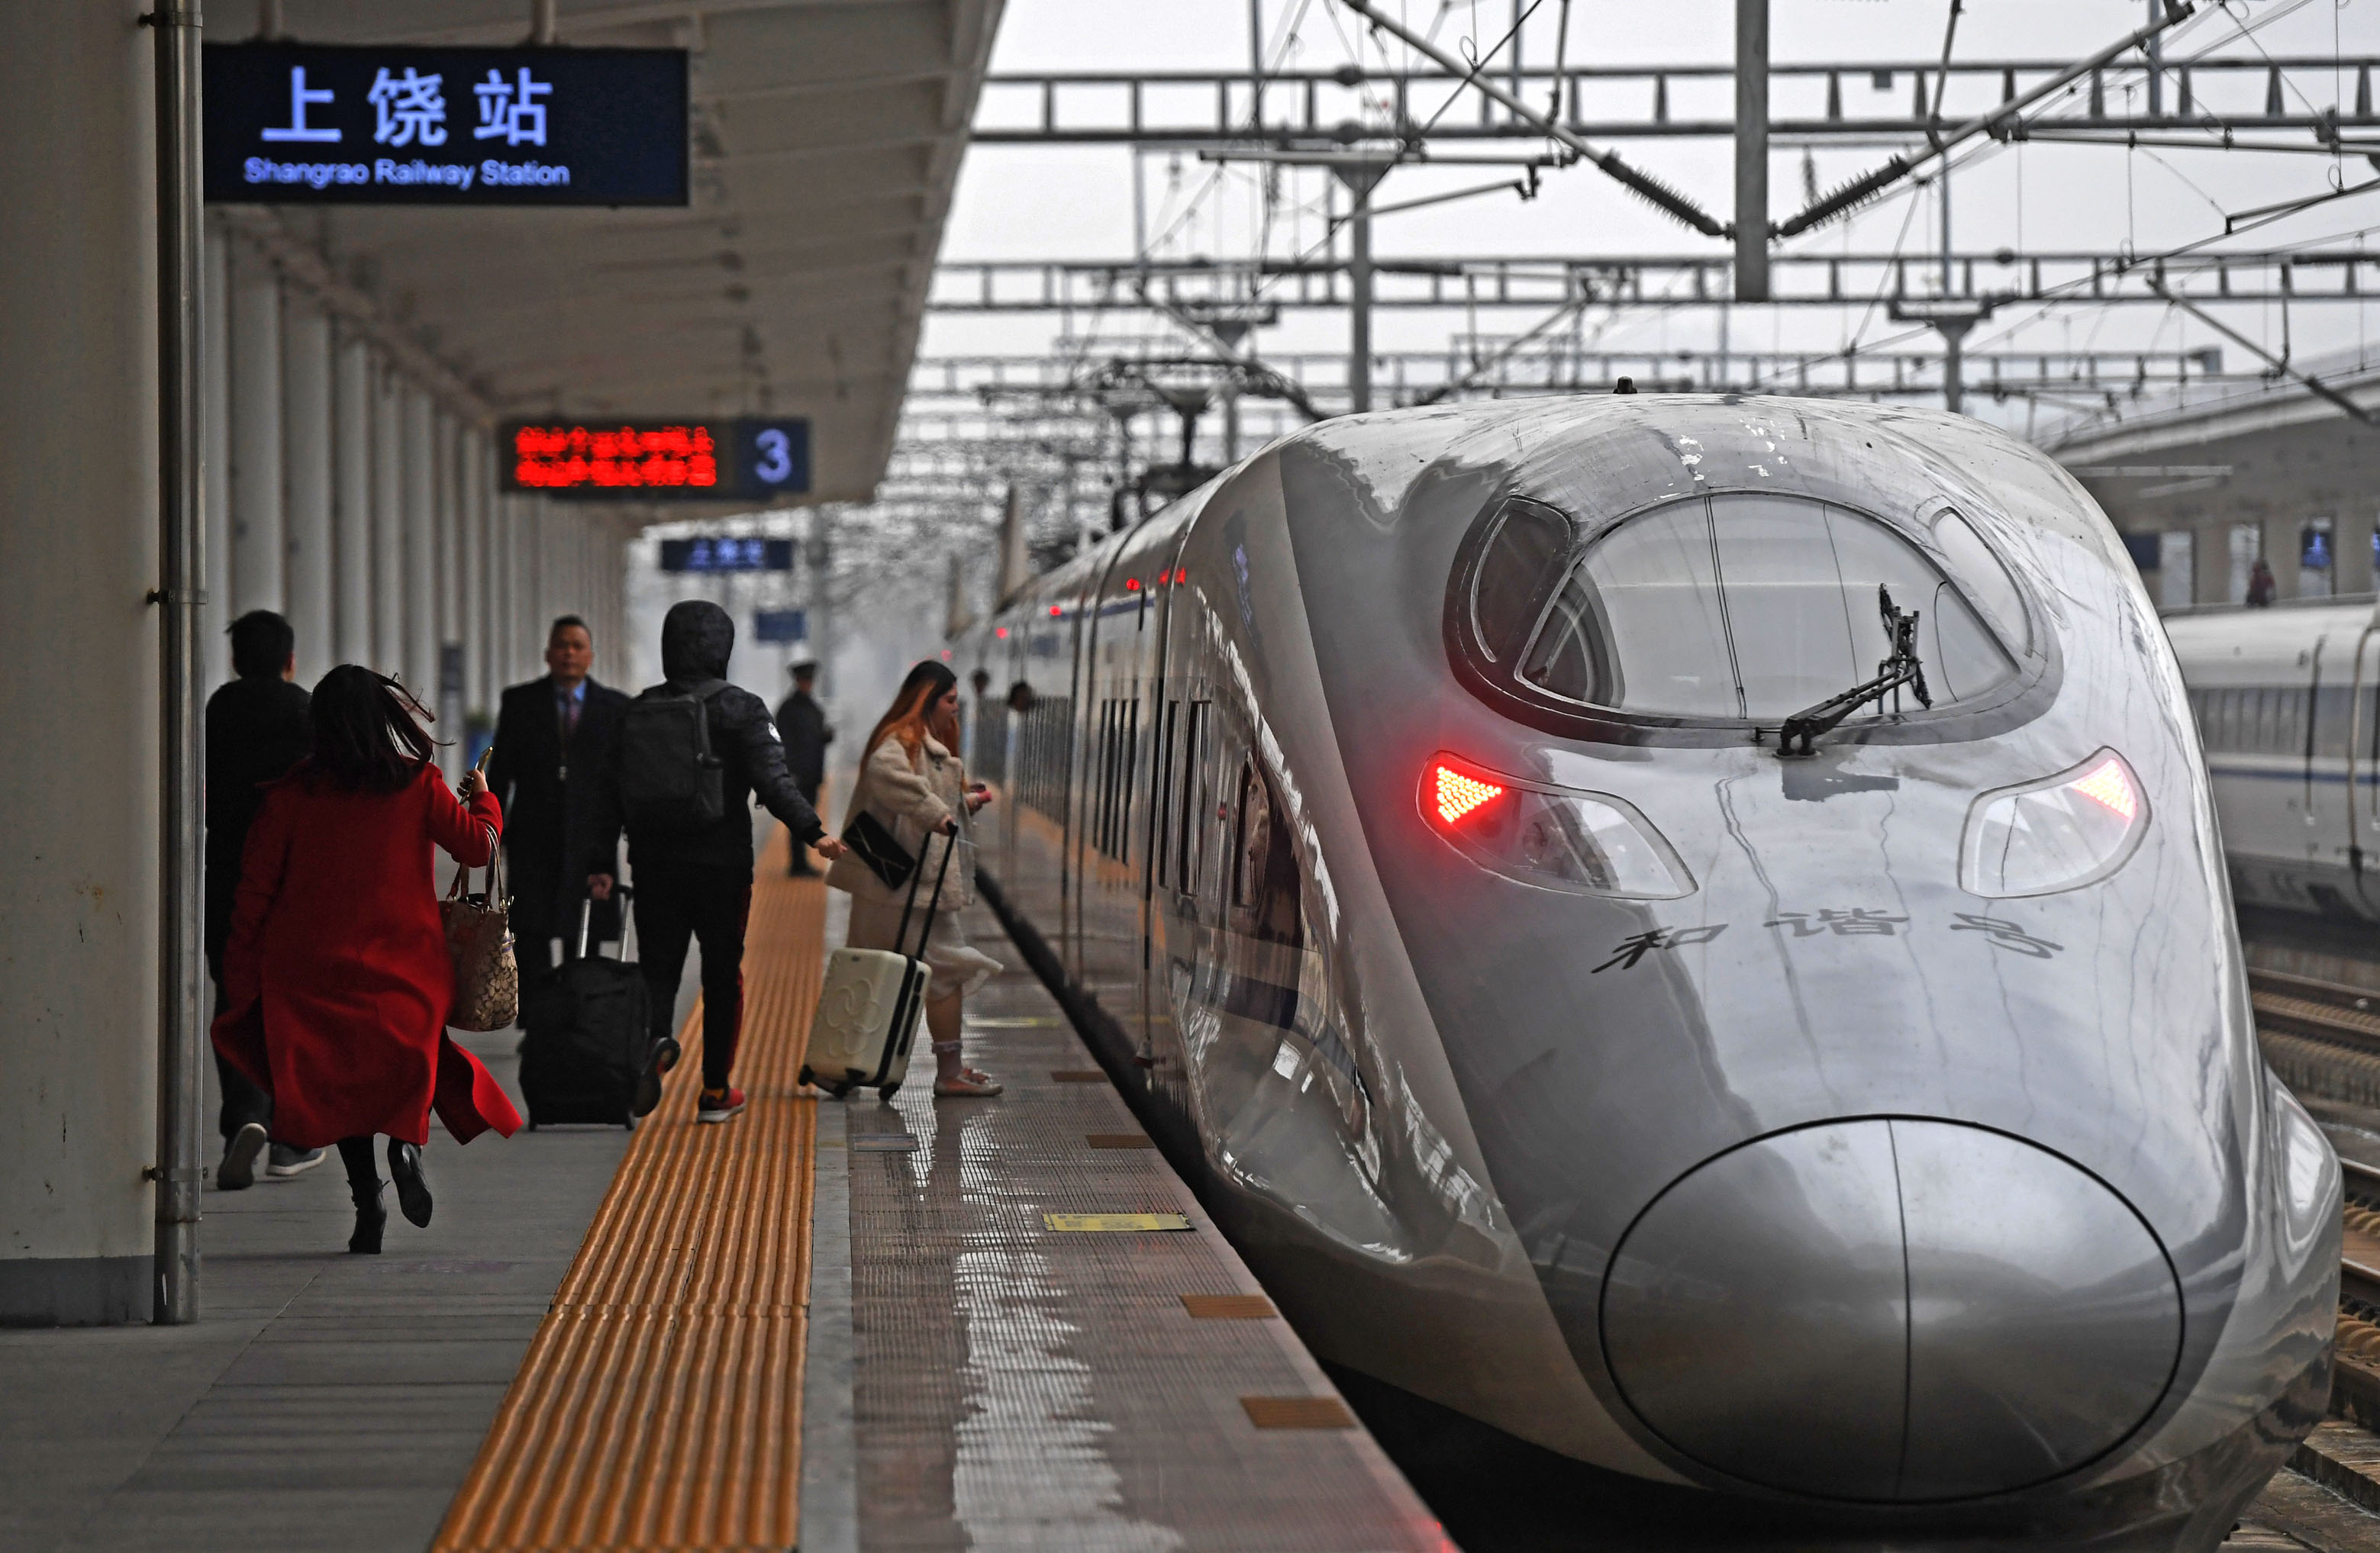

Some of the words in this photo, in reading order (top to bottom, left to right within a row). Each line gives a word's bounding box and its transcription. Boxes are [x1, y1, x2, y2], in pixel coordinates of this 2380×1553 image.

[261, 66, 553, 147] 上饶站
[243, 156, 369, 190] Shangrao
[375, 158, 476, 191] Railway
[481, 159, 571, 186] Station
[755, 428, 792, 484] 3
